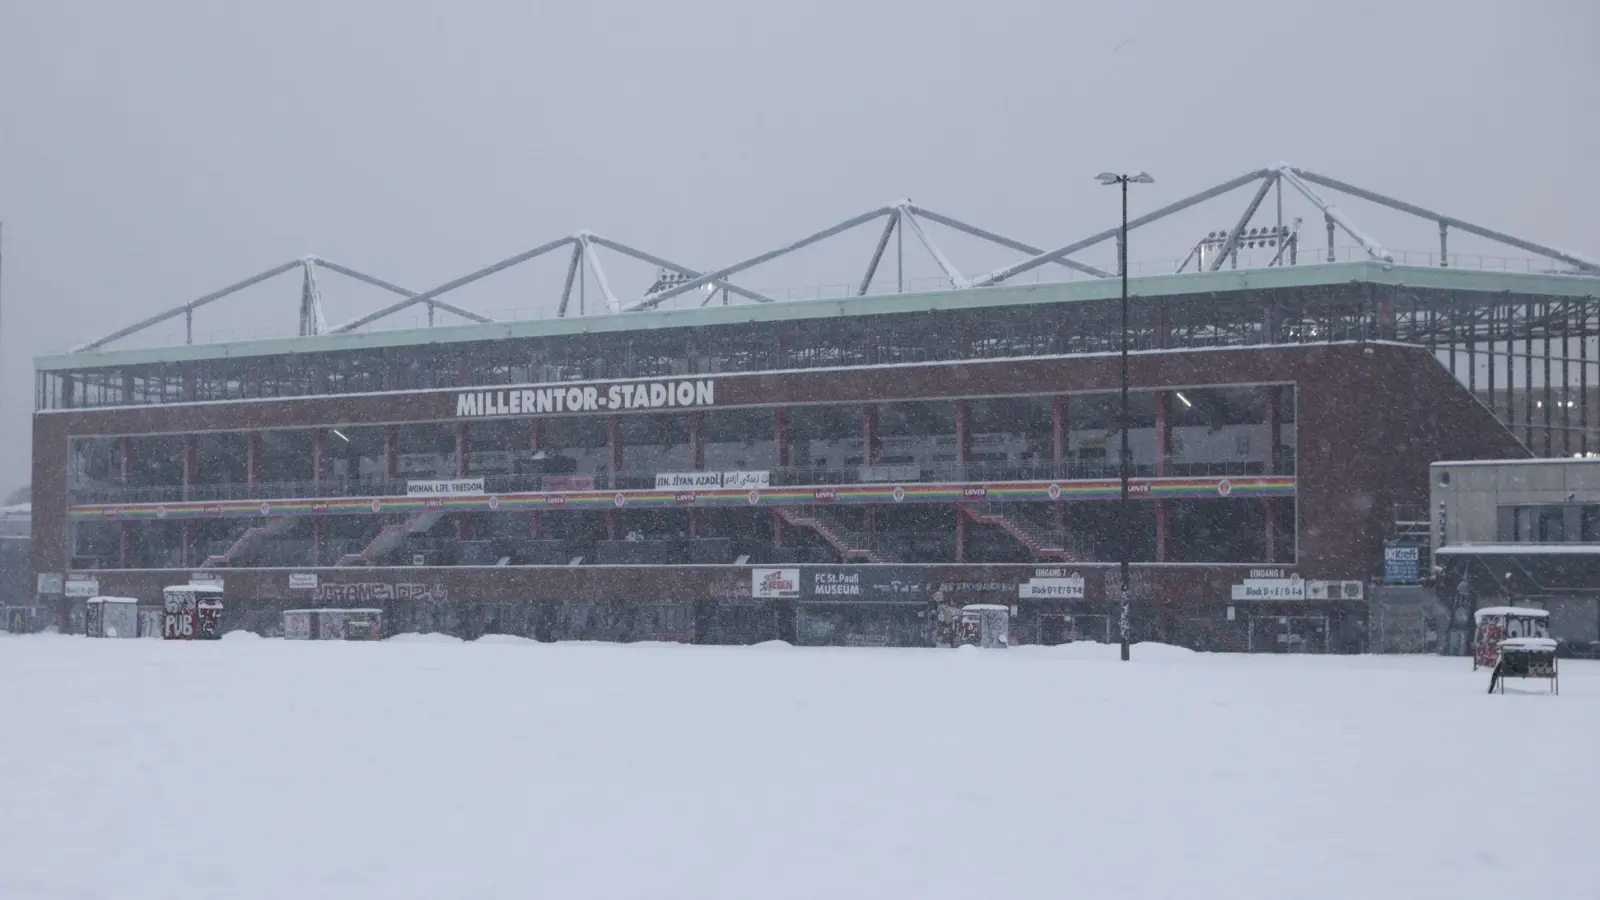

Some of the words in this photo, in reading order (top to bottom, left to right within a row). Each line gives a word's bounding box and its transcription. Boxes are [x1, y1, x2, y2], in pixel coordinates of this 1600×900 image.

[456, 380, 714, 416] MILLERNTOR-STADION
[1035, 568, 1061, 577] EINGANG
[1250, 568, 1279, 578] EINGANG
[815, 573, 826, 583] FC
[827, 573, 838, 583] St.
[839, 573, 859, 583] Pauli
[815, 584, 860, 595] MUSEUM
[1031, 586, 1046, 594] Block
[1245, 587, 1262, 596] Block
[165, 615, 194, 638] PUB
